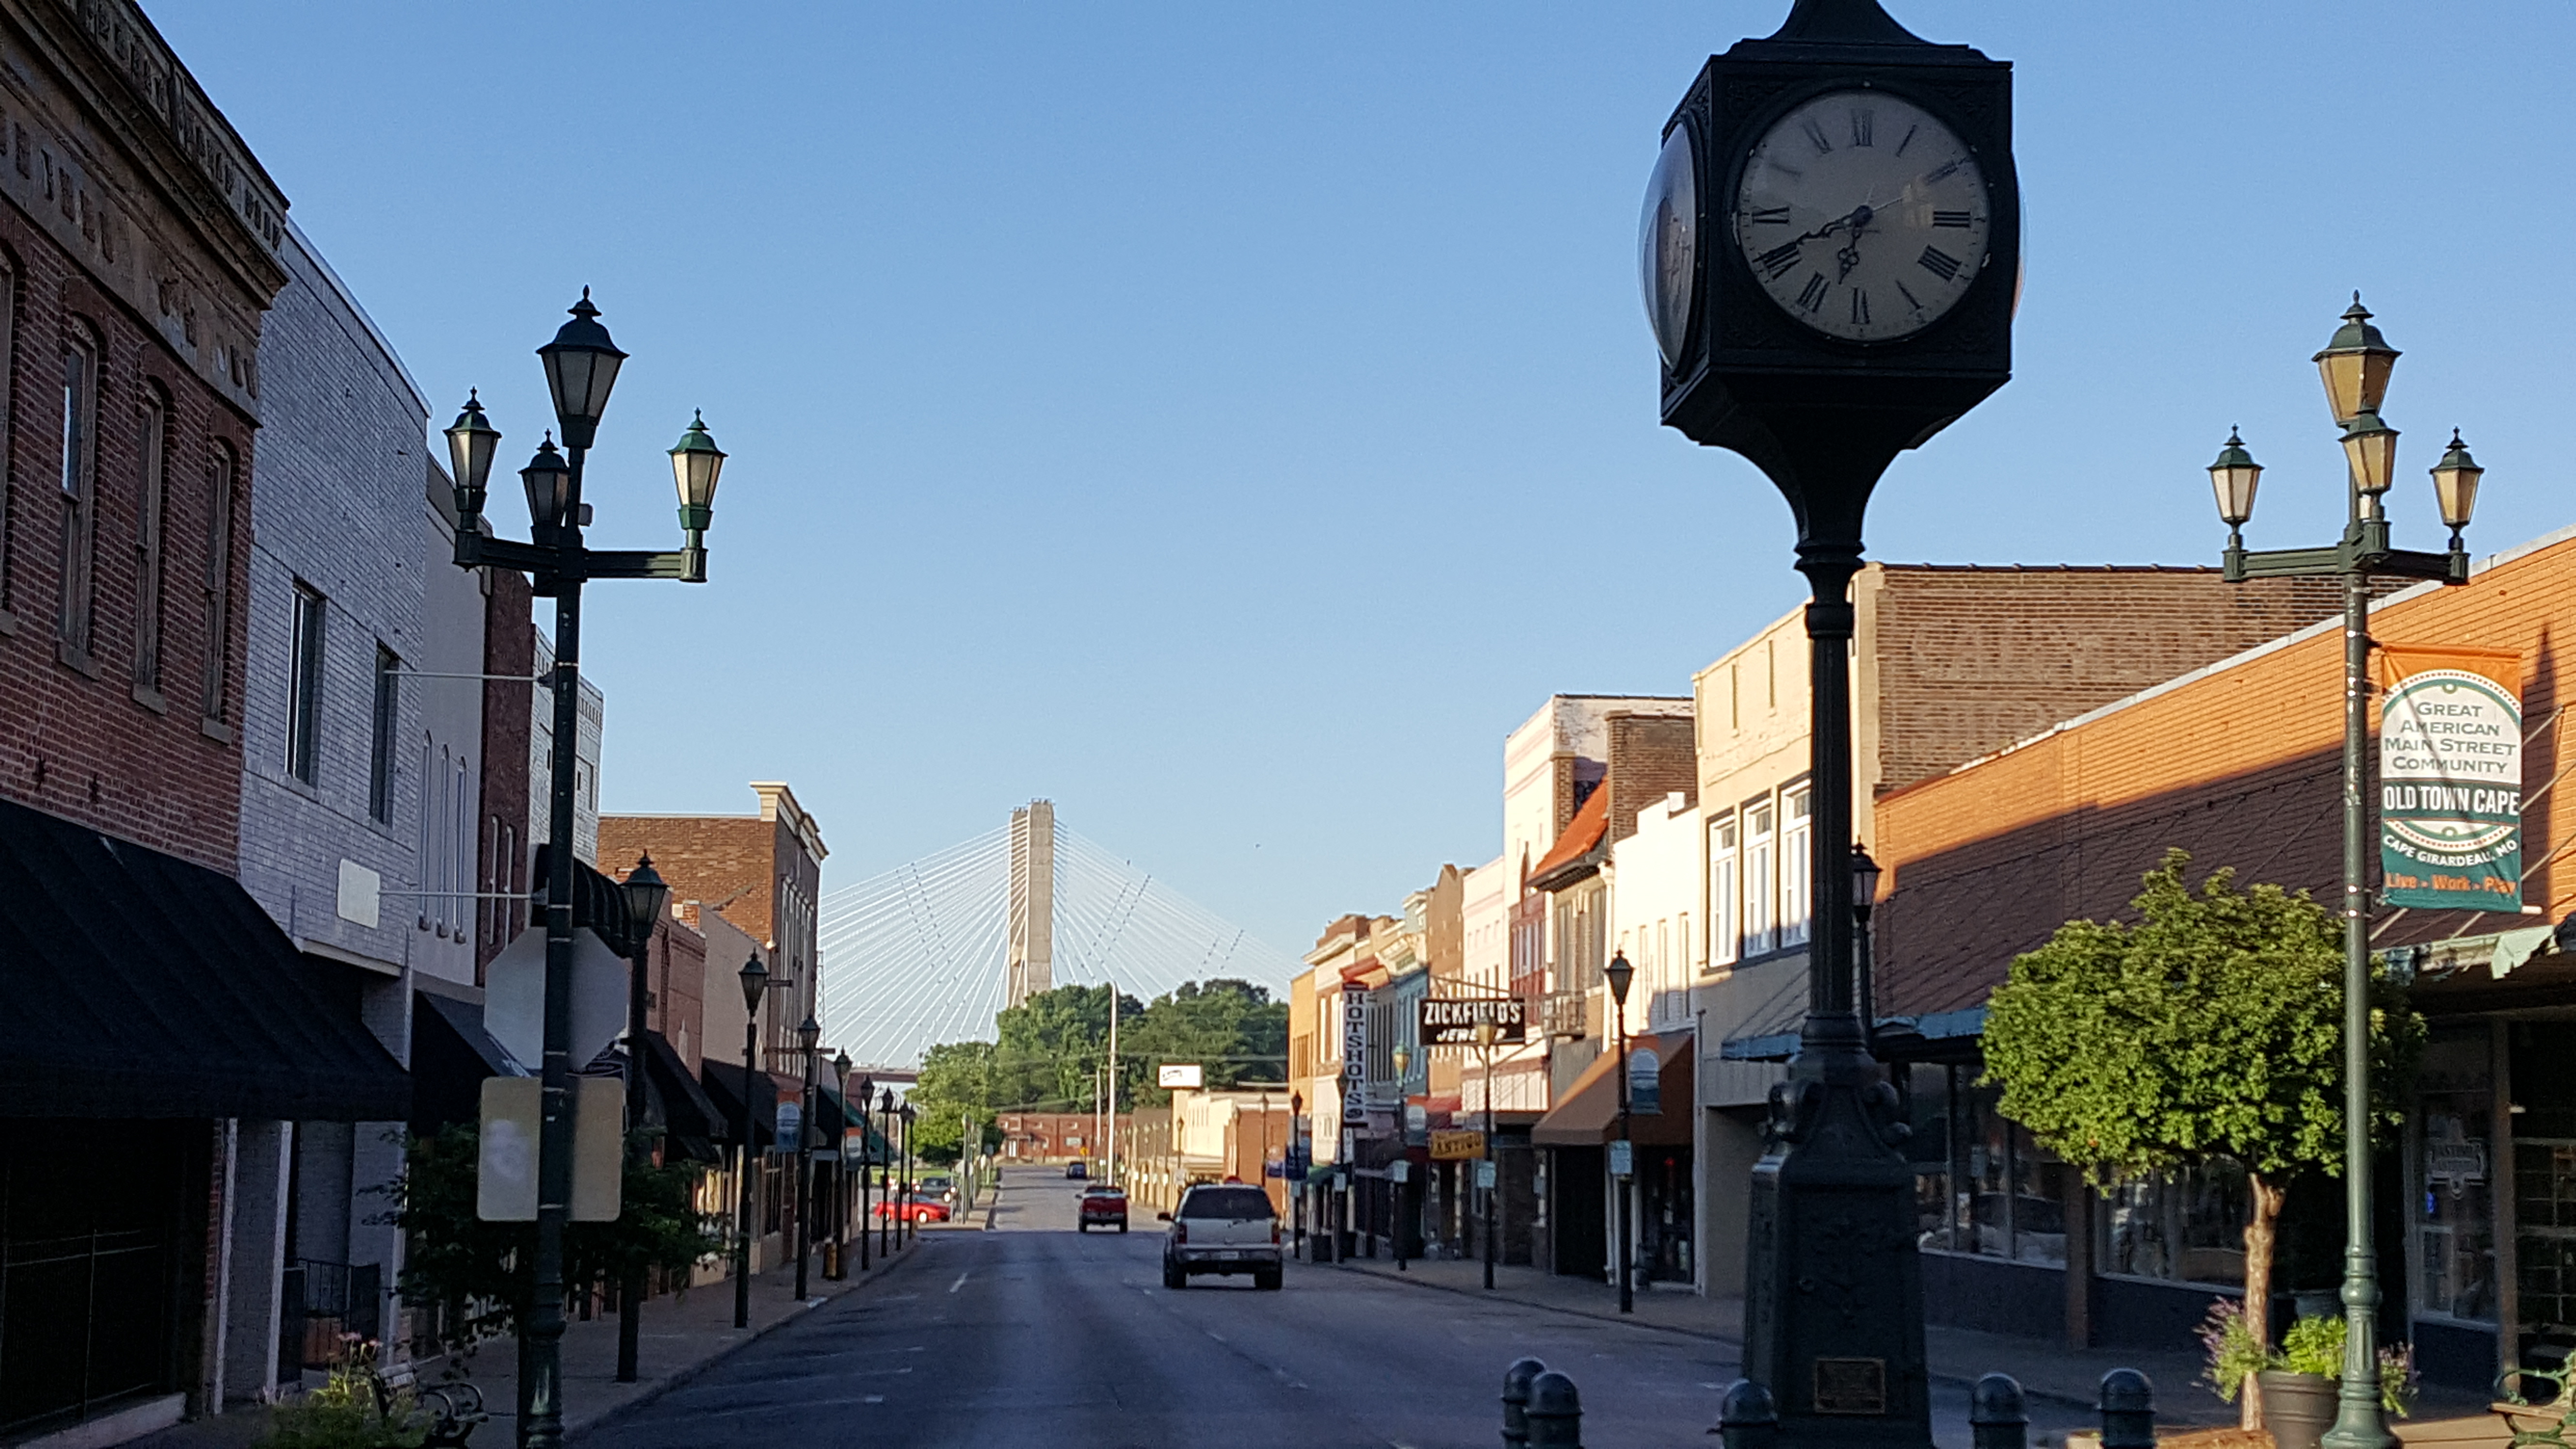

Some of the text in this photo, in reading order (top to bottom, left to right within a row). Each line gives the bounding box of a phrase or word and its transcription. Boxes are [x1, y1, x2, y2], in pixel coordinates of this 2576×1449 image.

[1850, 110, 1875, 147] XII
[1752, 205, 1790, 226] IX
[1932, 209, 1971, 228] III
[1917, 244, 1962, 284] IIII
[1796, 271, 1832, 314] VII
[1850, 287, 1871, 324] VI
[2416, 702, 2482, 717] GREAT
[2400, 720, 2499, 736] AMERICAN
[2384, 737, 2517, 756] MAIN STREET
[2392, 756, 2508, 773] COMMUNITY
[2383, 786, 2520, 816] OLD TOWN CAPE
[2383, 835, 2416, 858] CAPE
[2496, 839, 2518, 857] MO
[2385, 872, 2417, 889] Live
[2431, 874, 2471, 891] Work
[2483, 876, 2517, 896] Play
[1346, 993, 1365, 1106] HOTSHOTS
